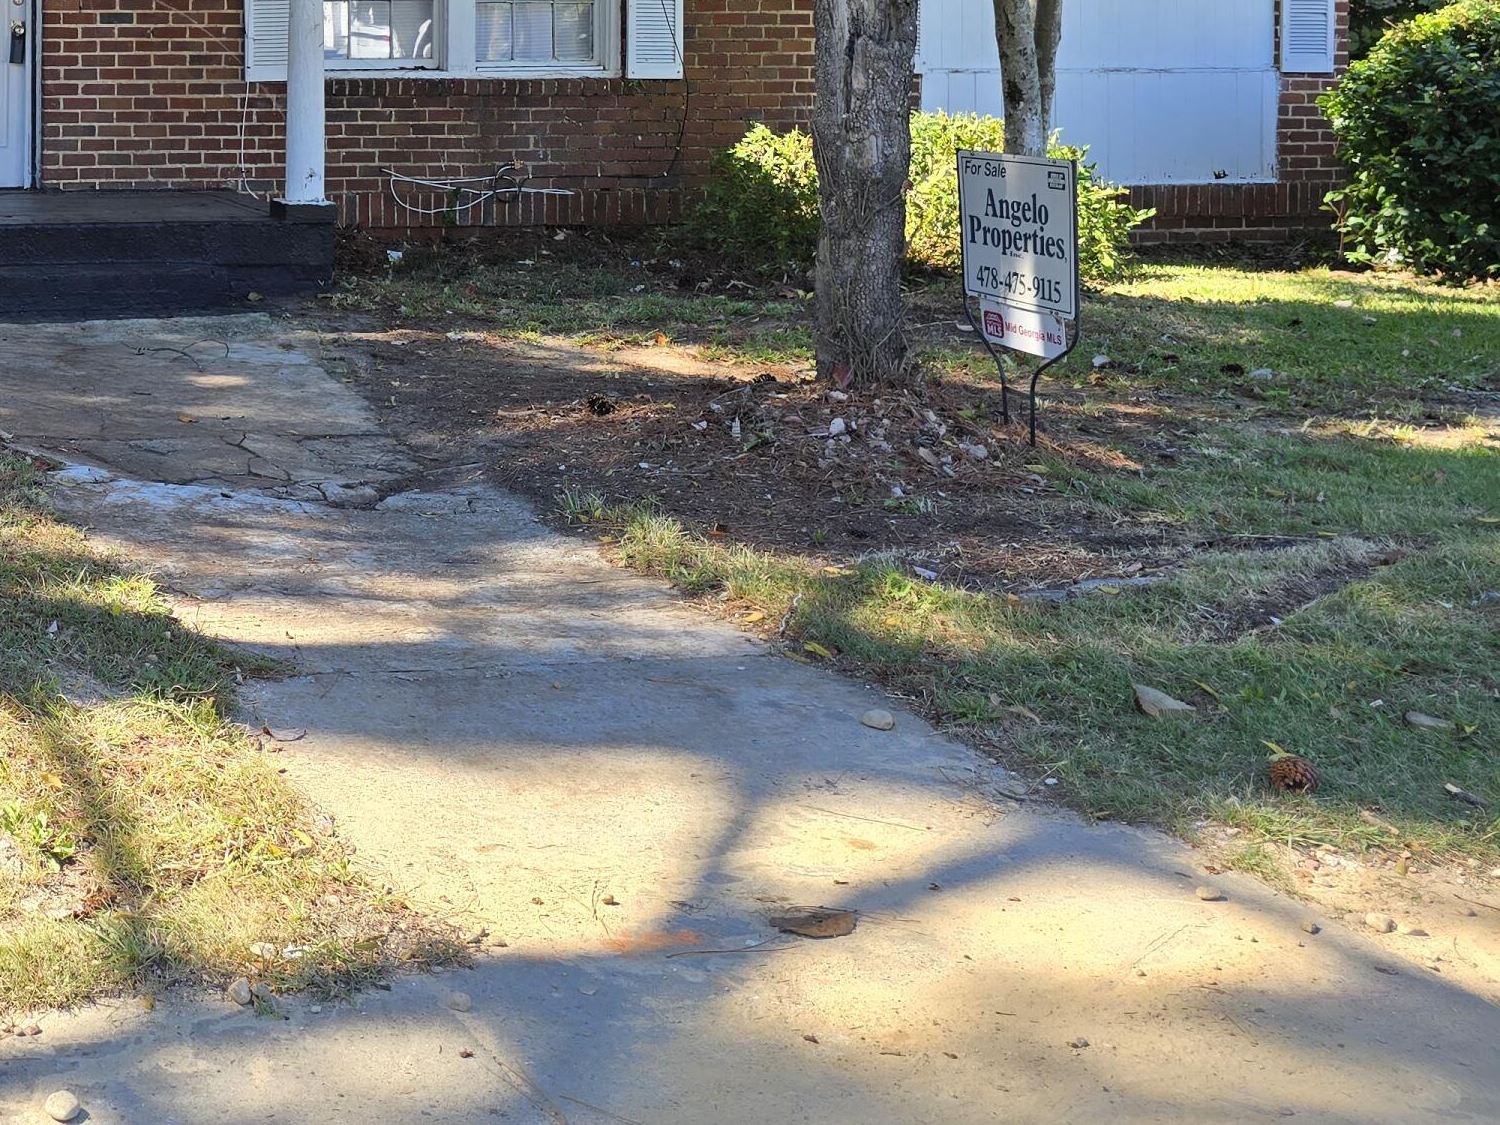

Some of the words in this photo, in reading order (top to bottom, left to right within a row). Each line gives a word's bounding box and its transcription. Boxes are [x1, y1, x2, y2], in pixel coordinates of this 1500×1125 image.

[964, 160, 981, 176] For
[984, 163, 1007, 179] Sale
[984, 188, 1049, 227] Angelo
[976, 265, 1062, 304] 478-475-9115
[986, 323, 1002, 337] MLS
[1004, 321, 1017, 335] Mid
[1018, 324, 1045, 342] Georgia
[1046, 331, 1062, 346] MLS
